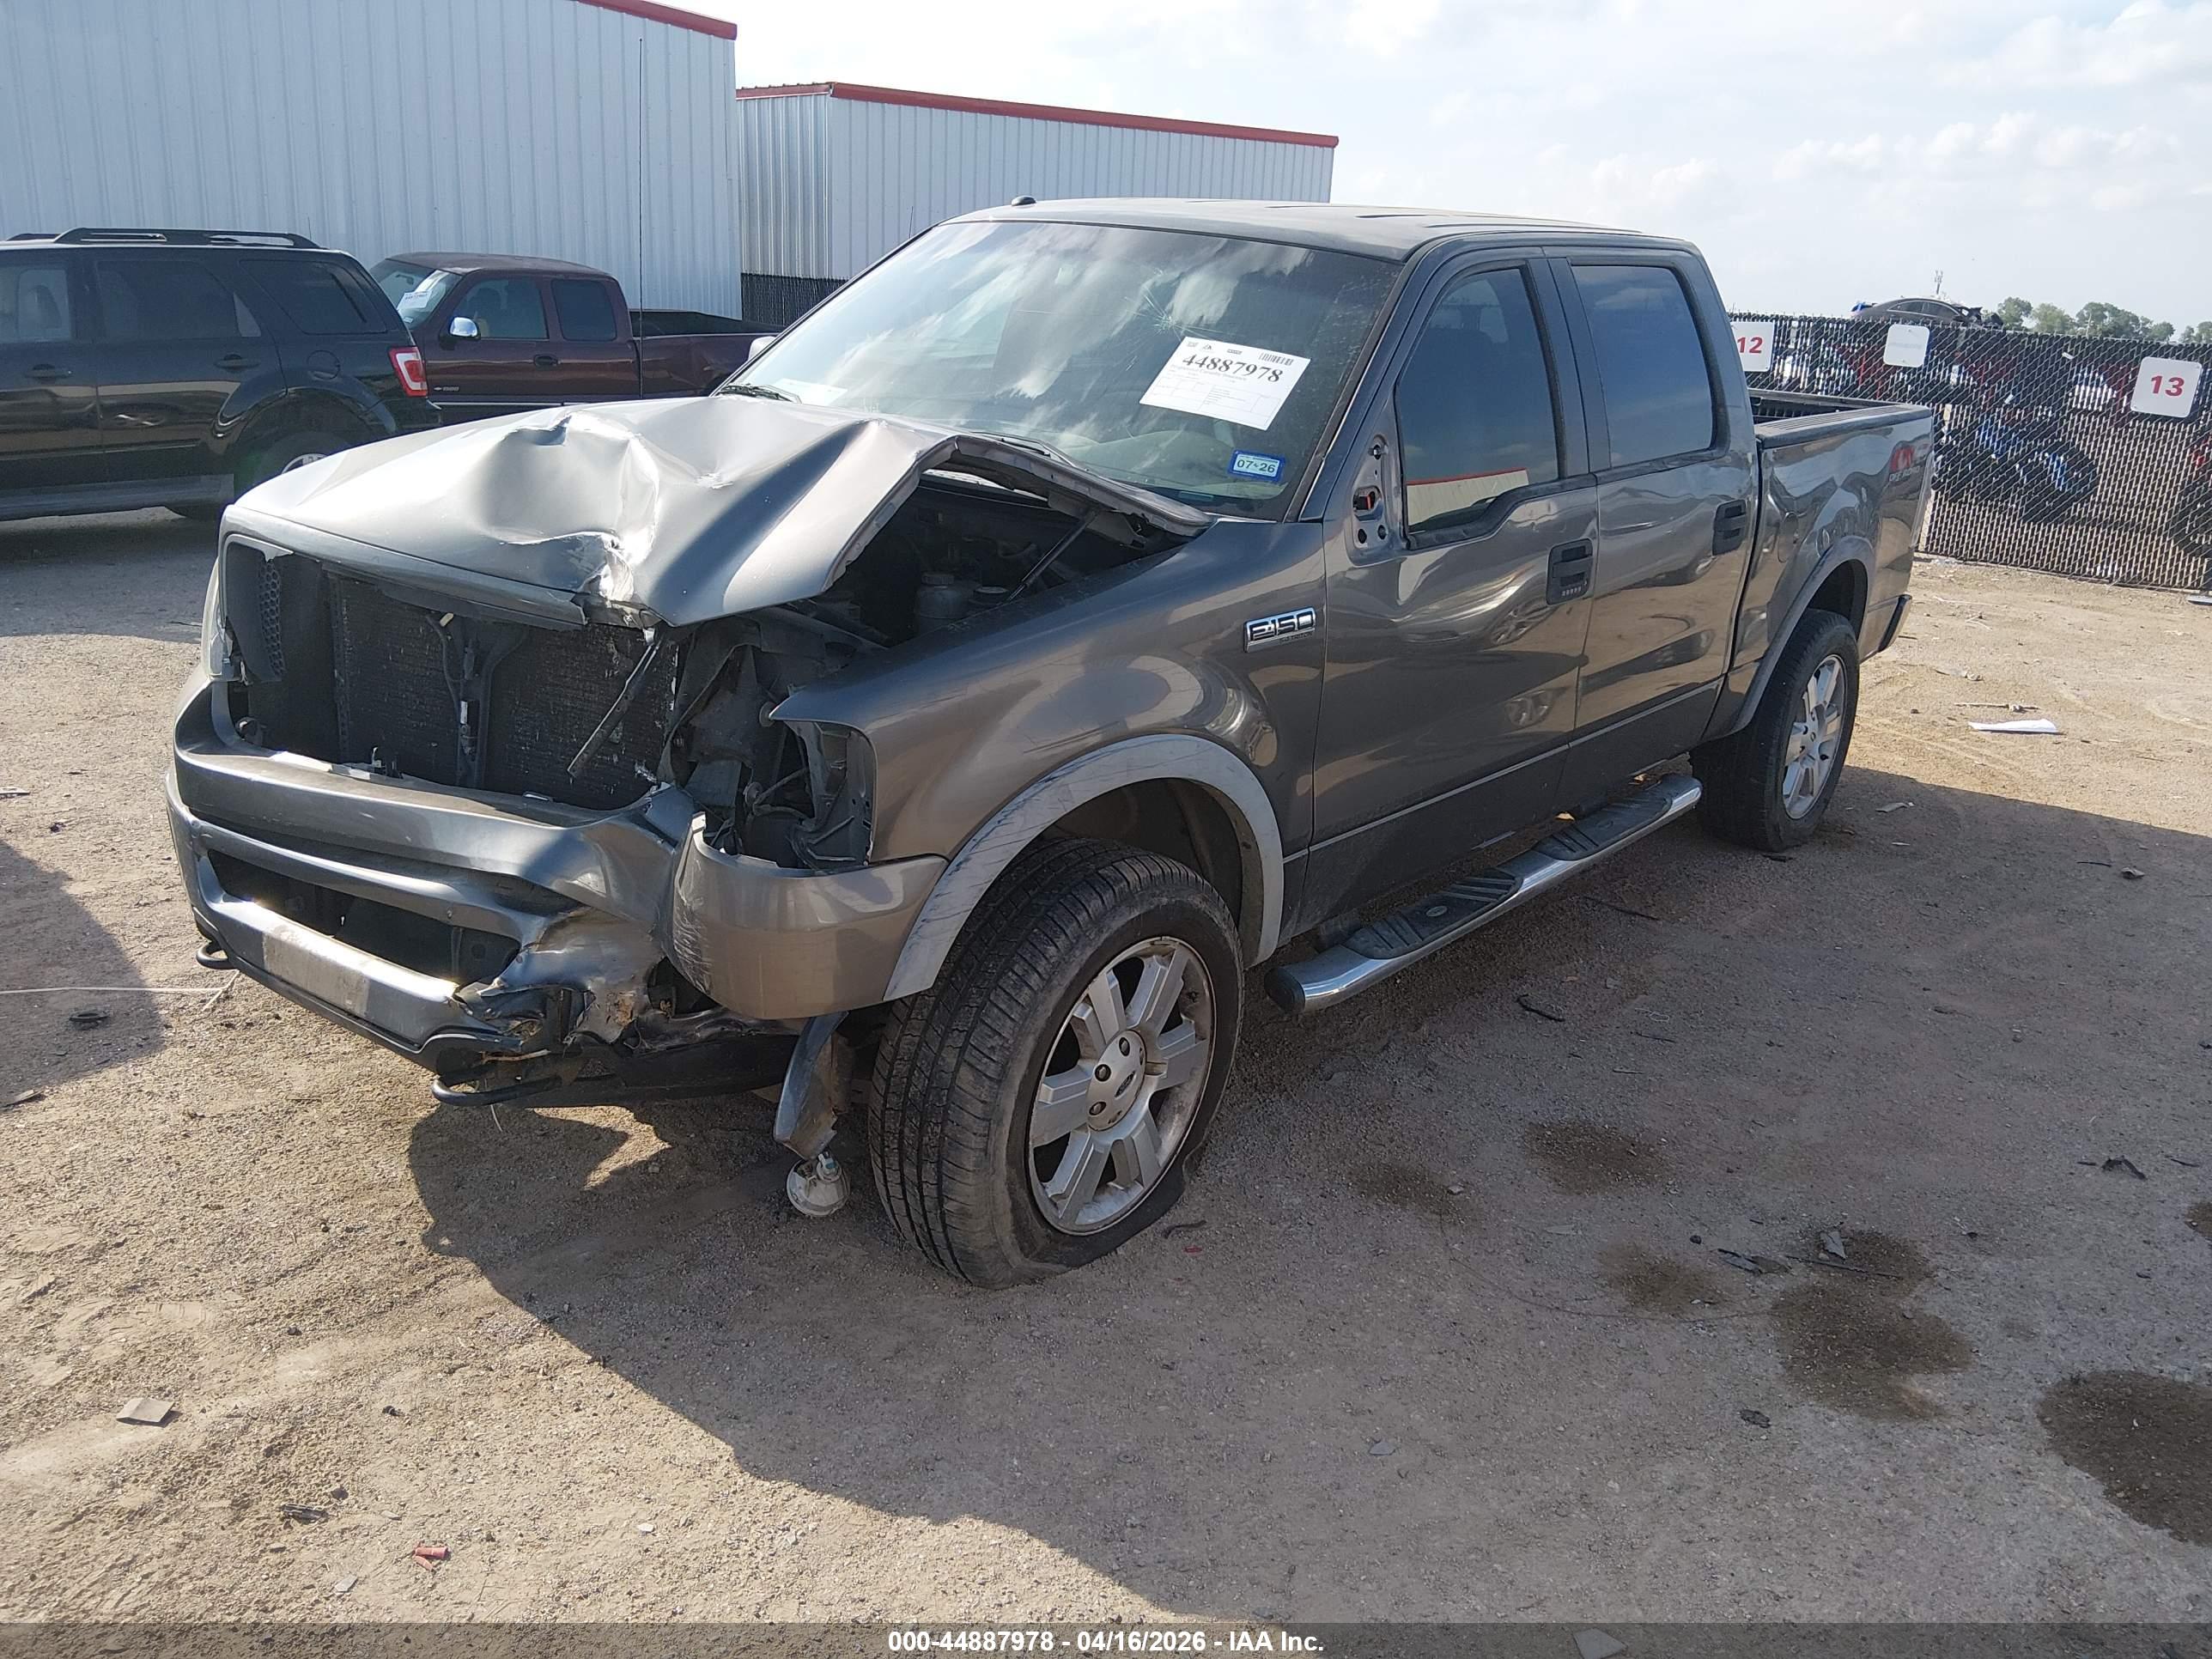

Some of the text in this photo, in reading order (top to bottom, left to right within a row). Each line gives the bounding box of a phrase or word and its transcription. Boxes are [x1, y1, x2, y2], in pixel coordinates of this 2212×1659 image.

[1736, 336, 1763, 354] 12
[1182, 353, 1284, 383] 44887978
[2150, 374, 2185, 397] 13
